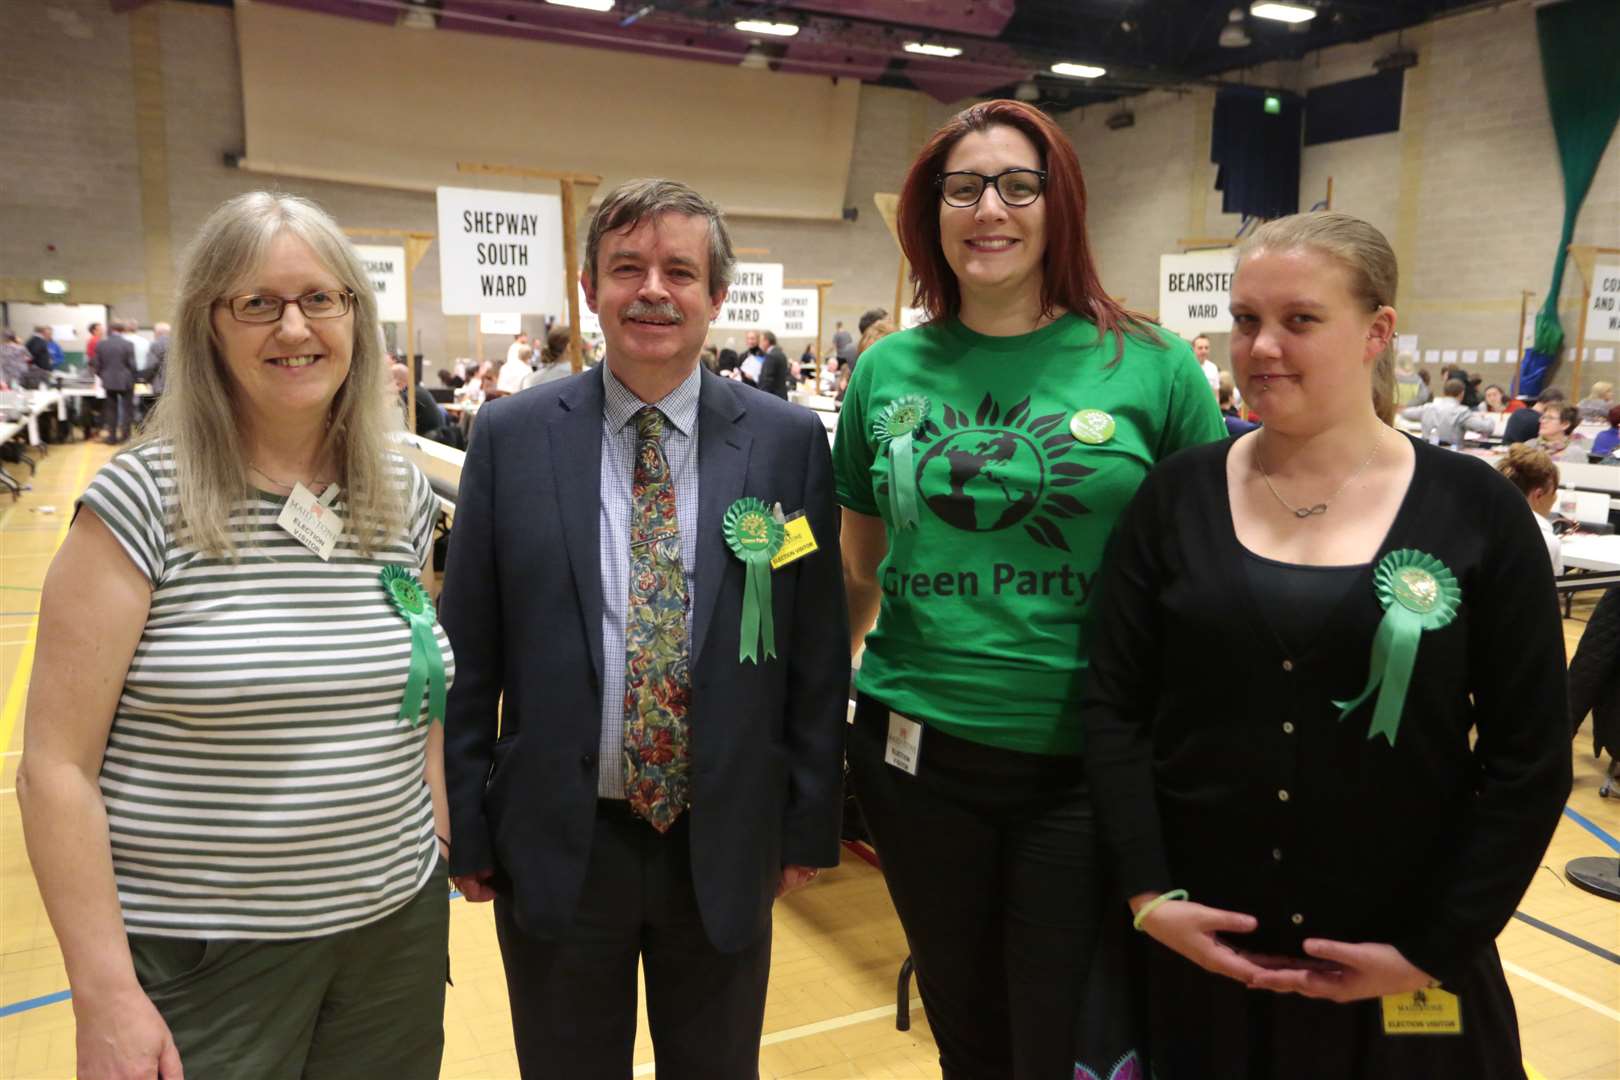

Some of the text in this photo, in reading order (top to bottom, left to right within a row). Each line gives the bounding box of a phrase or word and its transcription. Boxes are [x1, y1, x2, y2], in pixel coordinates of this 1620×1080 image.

[463, 210, 538, 236] SHEPWAY
[477, 242, 528, 266] SOUTH
[481, 275, 527, 297] WARD
[733, 272, 764, 287] ORTH
[1594, 296, 1616, 311] AND
[727, 308, 760, 323] WARD
[784, 309, 805, 318] NORTH
[1188, 304, 1219, 319] WARD
[785, 321, 804, 331] WARD
[293, 517, 326, 547] ELECTION
[881, 562, 1096, 607] Green Party
